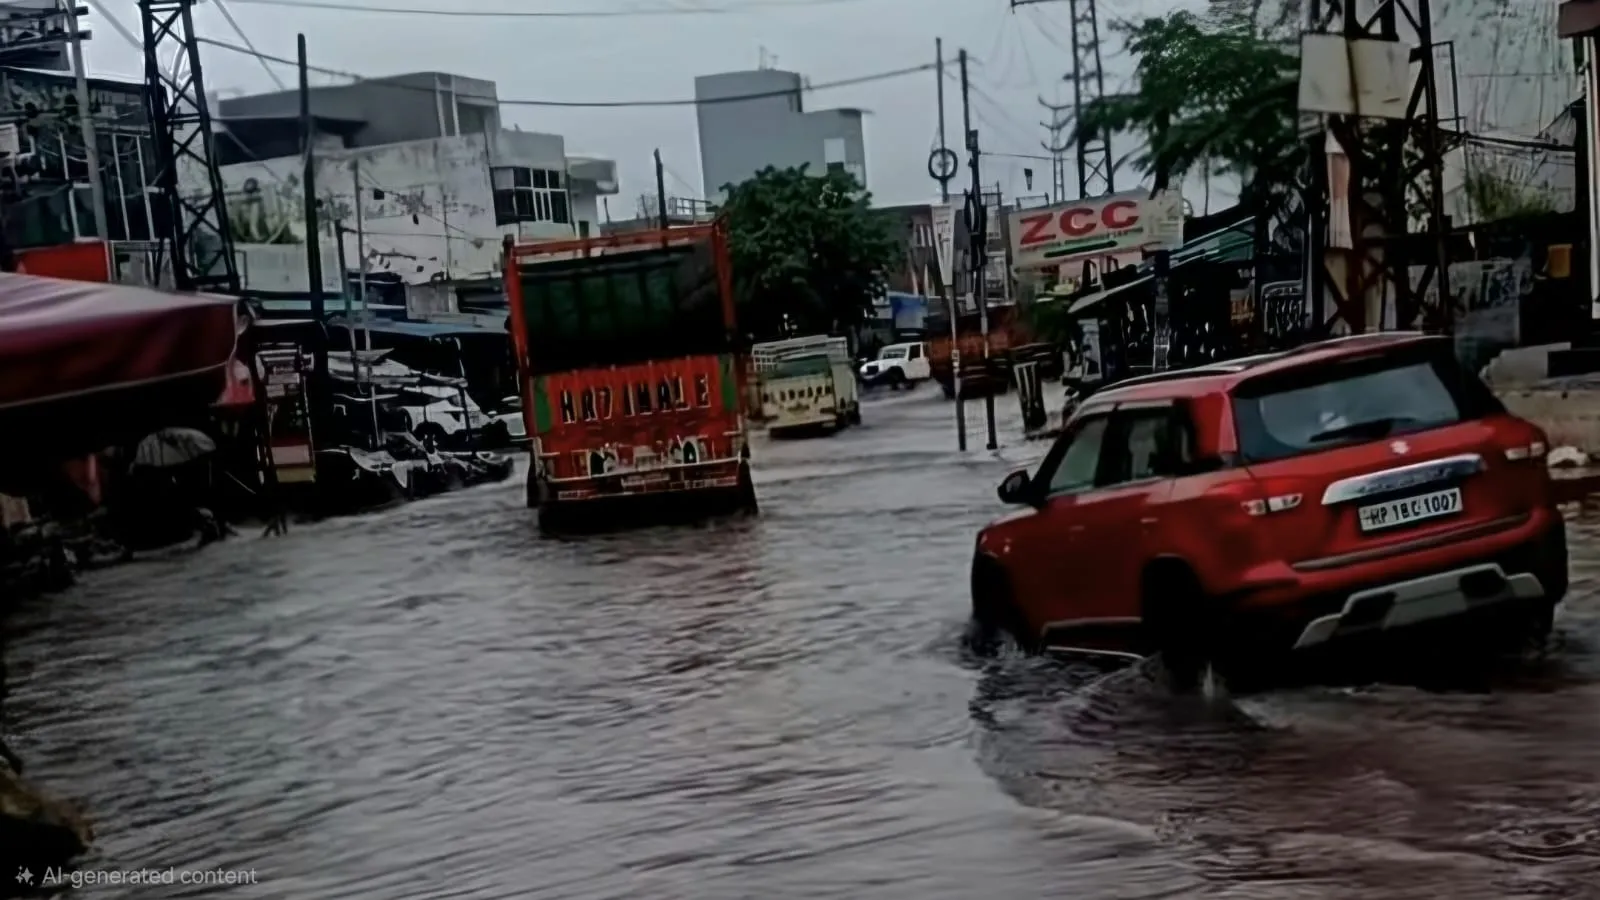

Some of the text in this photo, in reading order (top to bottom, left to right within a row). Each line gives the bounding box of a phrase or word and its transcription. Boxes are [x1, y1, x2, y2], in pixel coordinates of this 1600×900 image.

[1020, 200, 1139, 245] ZCC
[1370, 506, 1388, 525] HP
[1424, 491, 1458, 513] 1007
